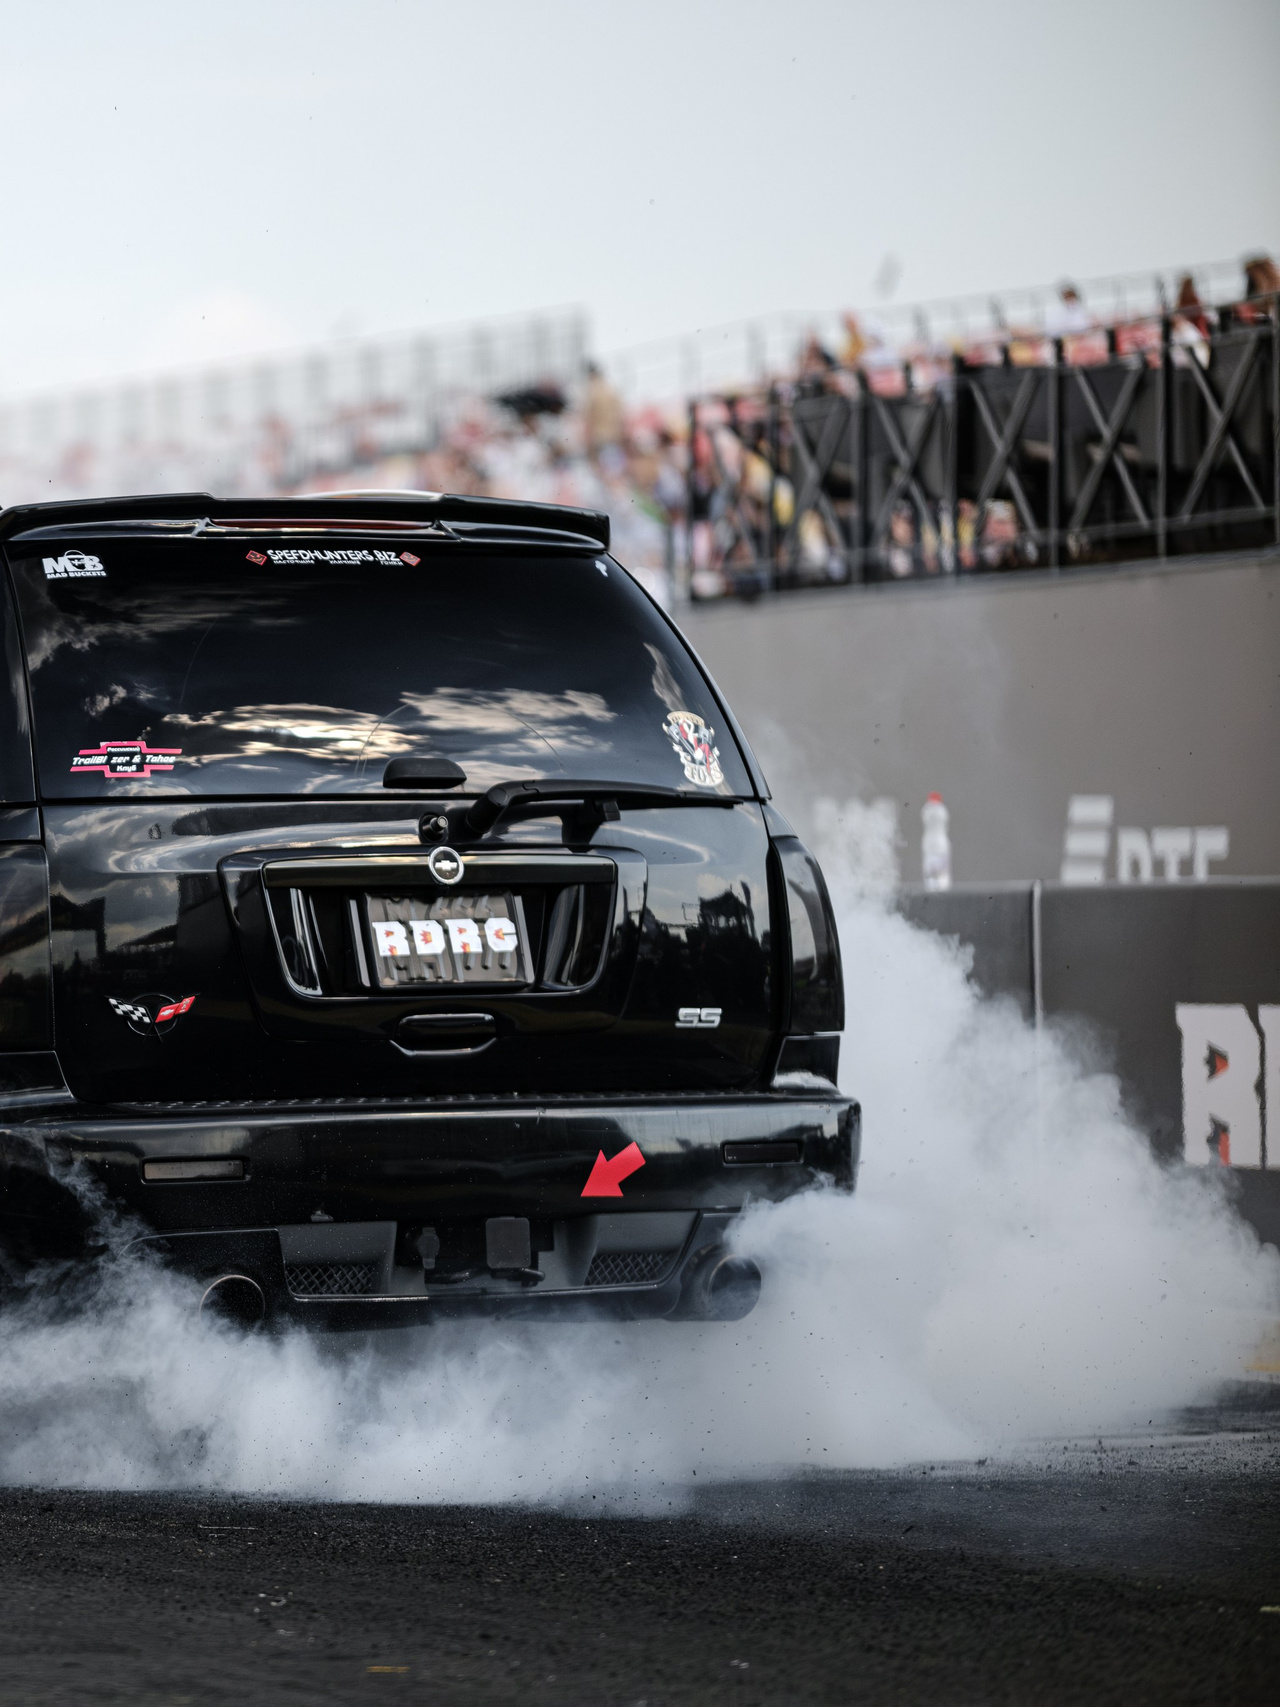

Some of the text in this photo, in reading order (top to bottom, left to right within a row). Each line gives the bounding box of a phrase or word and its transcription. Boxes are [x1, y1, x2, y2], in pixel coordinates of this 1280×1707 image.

[46, 572, 68, 580] MAD
[145, 754, 176, 763] Tahoe
[675, 1007, 723, 1028] SS
